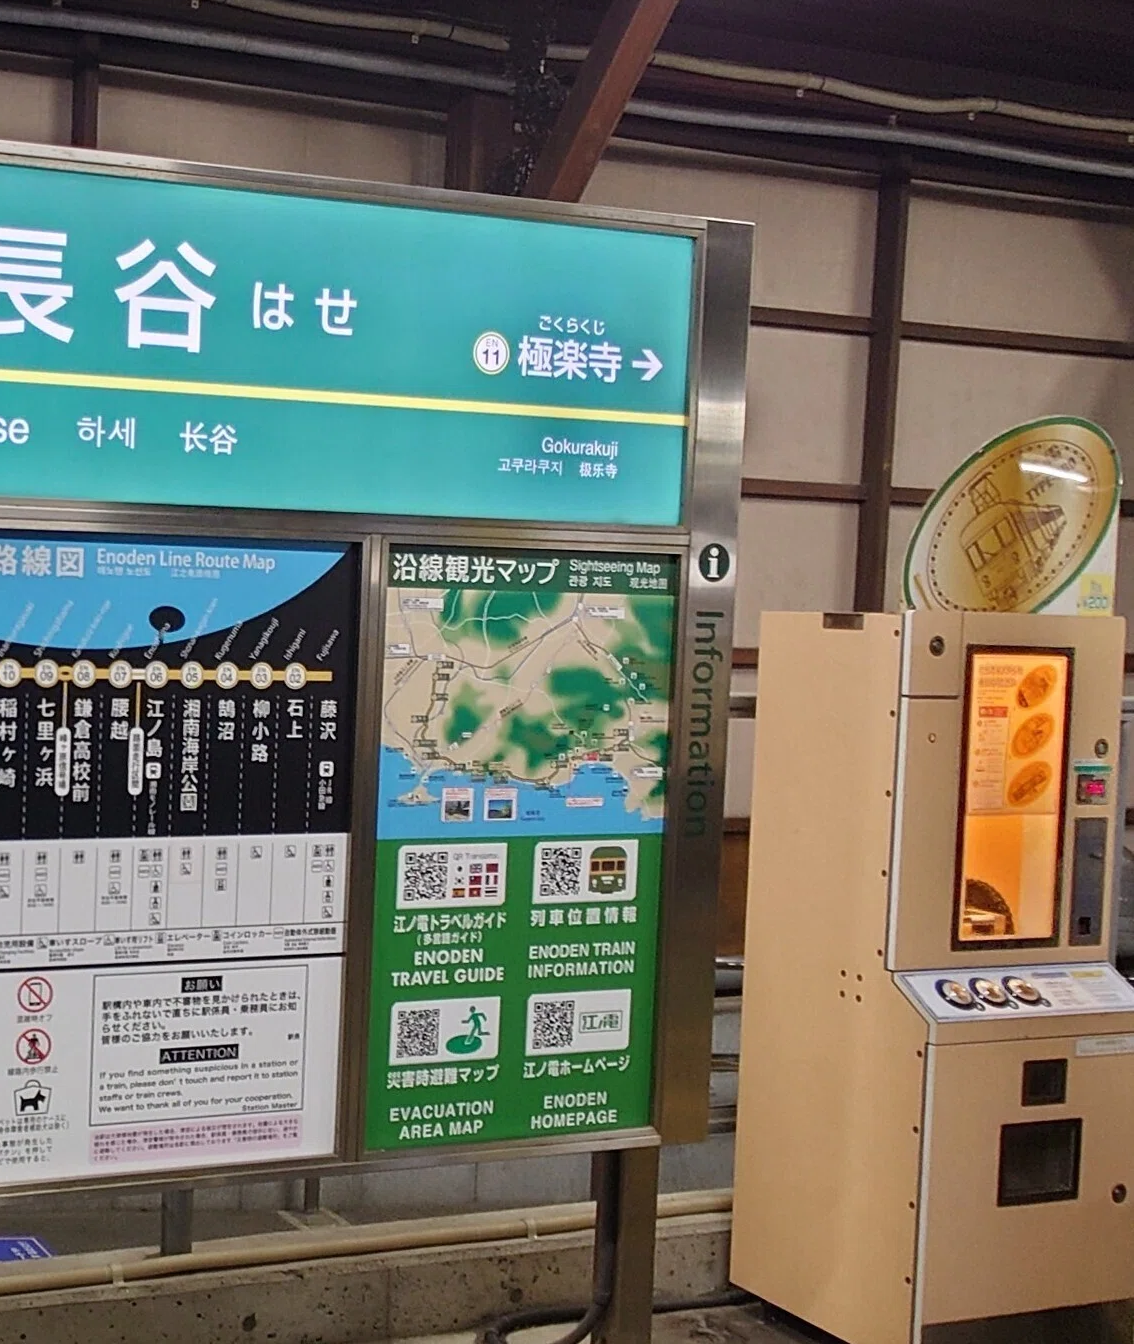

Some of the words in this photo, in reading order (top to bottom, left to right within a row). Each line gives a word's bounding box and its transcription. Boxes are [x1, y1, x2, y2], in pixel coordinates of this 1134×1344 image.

[253, 280, 358, 337] はせ
[539, 315, 605, 336] ごくらくじ
[485, 338, 499, 348] EN
[482, 348, 500, 366] 11
[518, 335, 622, 383] 極楽寺
[77, 414, 137, 450] 하세
[179, 421, 238, 457] 长谷
[541, 437, 619, 461] Gokurakuji
[498, 458, 563, 477] 고쿠라쿠지
[579, 462, 618, 479] 极乐寺
[96, 547, 156, 567] Enoden
[159, 550, 193, 568] Line
[195, 553, 238, 570] Route
[242, 554, 275, 574] Map
[392, 553, 560, 586] 沿線観光マップ
[569, 559, 634, 577] Sightseeing
[636, 561, 661, 575] Map
[248, 616, 281, 661] Yanagikouji
[282, 627, 307, 662] Ishigami
[315, 628, 341, 663] Fujisawa
[109, 698, 130, 741] 腰越
[145, 698, 165, 758] 江ノ島
[217, 699, 236, 741] 鵠沼
[250, 699, 271, 763] 柳小路
[285, 699, 305, 740] 石上
[319, 700, 338, 741] 藤沢
[683, 610, 726, 838] Information
[34, 697, 56, 788] 七里ヶ浜
[72, 698, 93, 803] 鎌倉高校前
[179, 698, 201, 812] 湘南海岸公園
[393, 912, 507, 934] 江ノ電トラベルガイド
[530, 906, 637, 928] 列車位置情報
[167, 931, 212, 942] エレベーター
[222, 929, 273, 940] コインロッカー
[413, 948, 484, 966] ENODEN
[528, 942, 590, 960] ENODEN
[593, 940, 636, 957] TRAIN
[391, 970, 450, 987] TRAVEL
[454, 967, 505, 984] GUIDE
[527, 959, 635, 979] INFORMATION
[183, 978, 221, 992] お願い
[101, 1020, 166, 1033] らせください。
[160, 1046, 238, 1063] ATTENTION
[109, 1071, 125, 1080] you
[128, 1068, 144, 1077] find
[147, 1066, 191, 1078] something
[194, 1062, 238, 1074] suspicious
[258, 1058, 287, 1068] station
[386, 1063, 500, 1090] 災害時避難マップ
[523, 1054, 630, 1079] 江ノ電ホームページ
[389, 1100, 494, 1122] EVACUATION
[543, 1091, 608, 1110] ENODEN
[398, 1122, 446, 1141] AREA
[449, 1119, 484, 1137] MAP
[530, 1109, 618, 1131] HOMEPAGE
